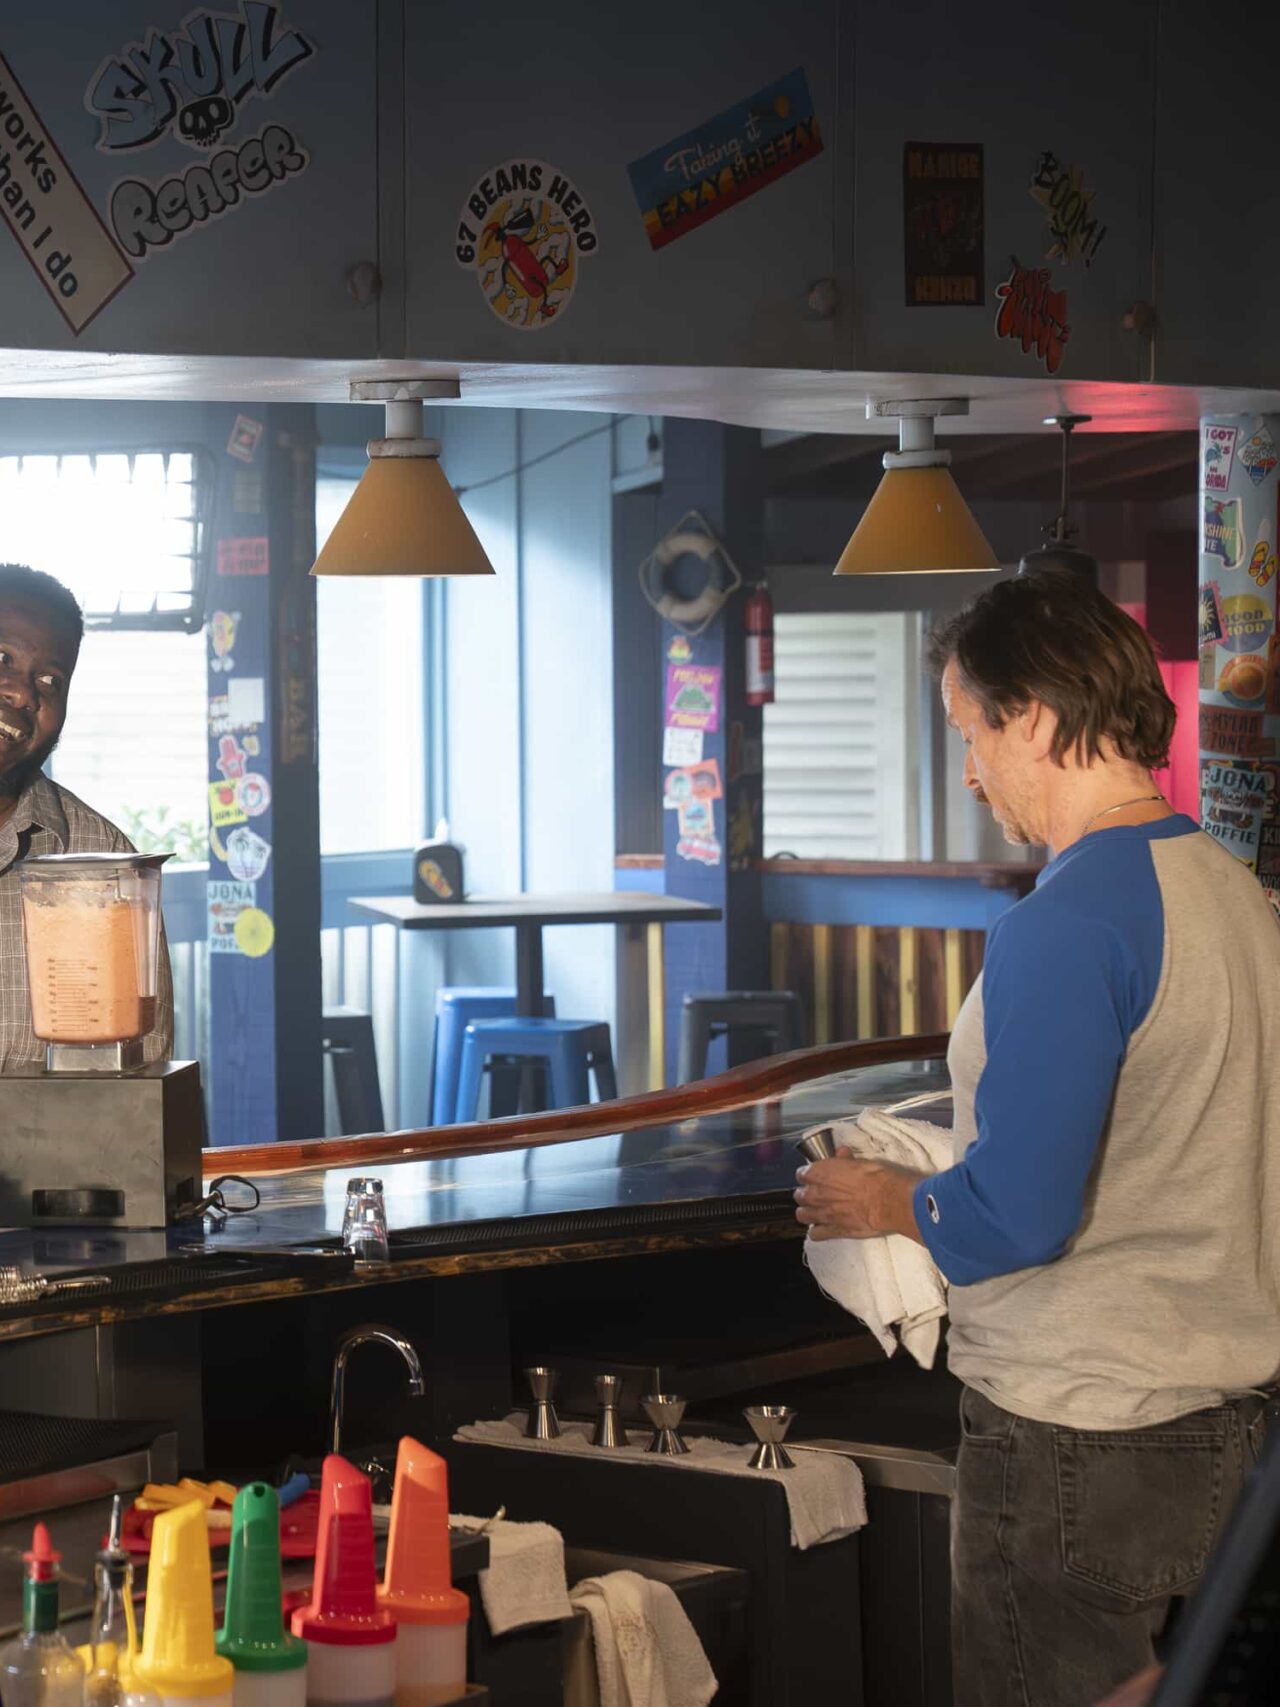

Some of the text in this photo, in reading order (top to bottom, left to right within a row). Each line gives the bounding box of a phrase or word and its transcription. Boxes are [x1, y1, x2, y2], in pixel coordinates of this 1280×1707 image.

[91, 1, 313, 149] SKULL
[663, 111, 761, 181] Taking it
[456, 163, 597, 263] 67 BEANS HERO
[33, 227, 52, 249] I
[45, 250, 78, 298] do
[1210, 429, 1235, 442] GOT
[1205, 820, 1258, 845] POFFIE
